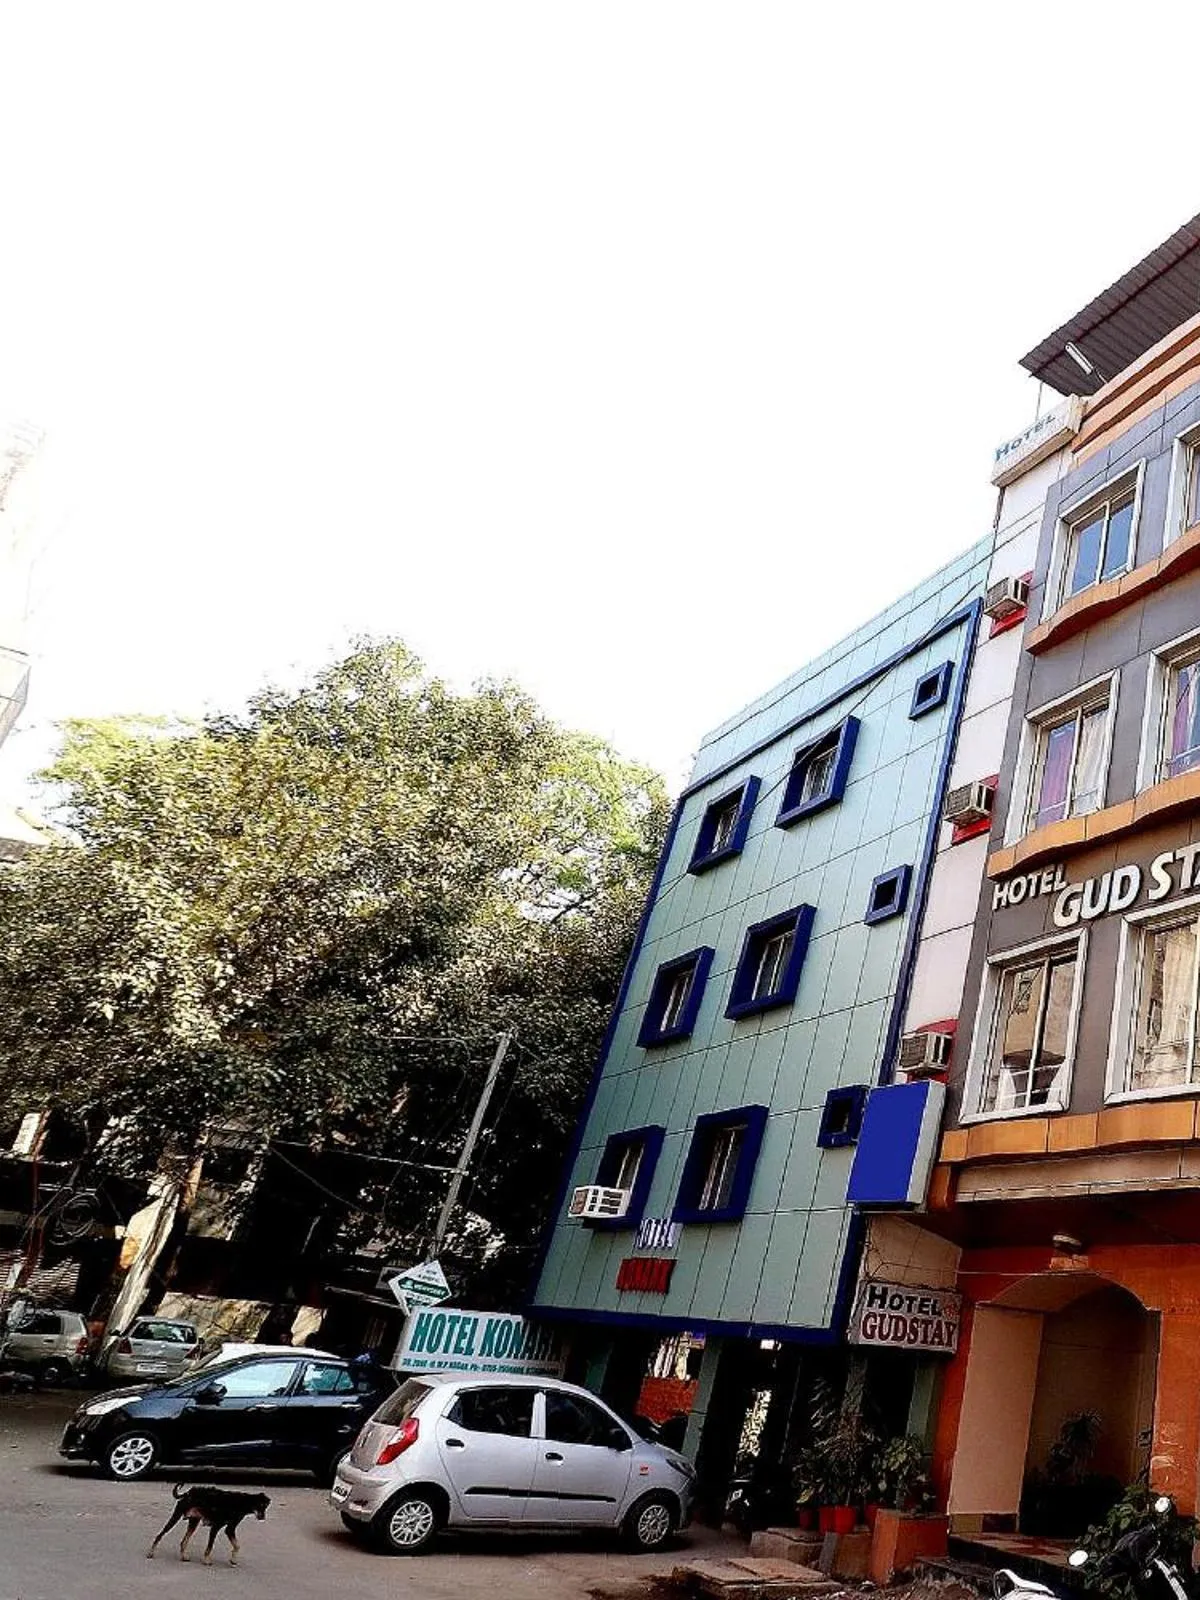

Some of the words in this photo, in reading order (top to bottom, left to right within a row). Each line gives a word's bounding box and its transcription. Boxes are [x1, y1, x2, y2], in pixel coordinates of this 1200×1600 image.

[991, 863, 1067, 911] HOTEL
[1053, 864, 1143, 928] GUD
[866, 1285, 942, 1316] HOTEL
[408, 1312, 479, 1356] HOTEL
[861, 1311, 958, 1347] GUDSTAY
